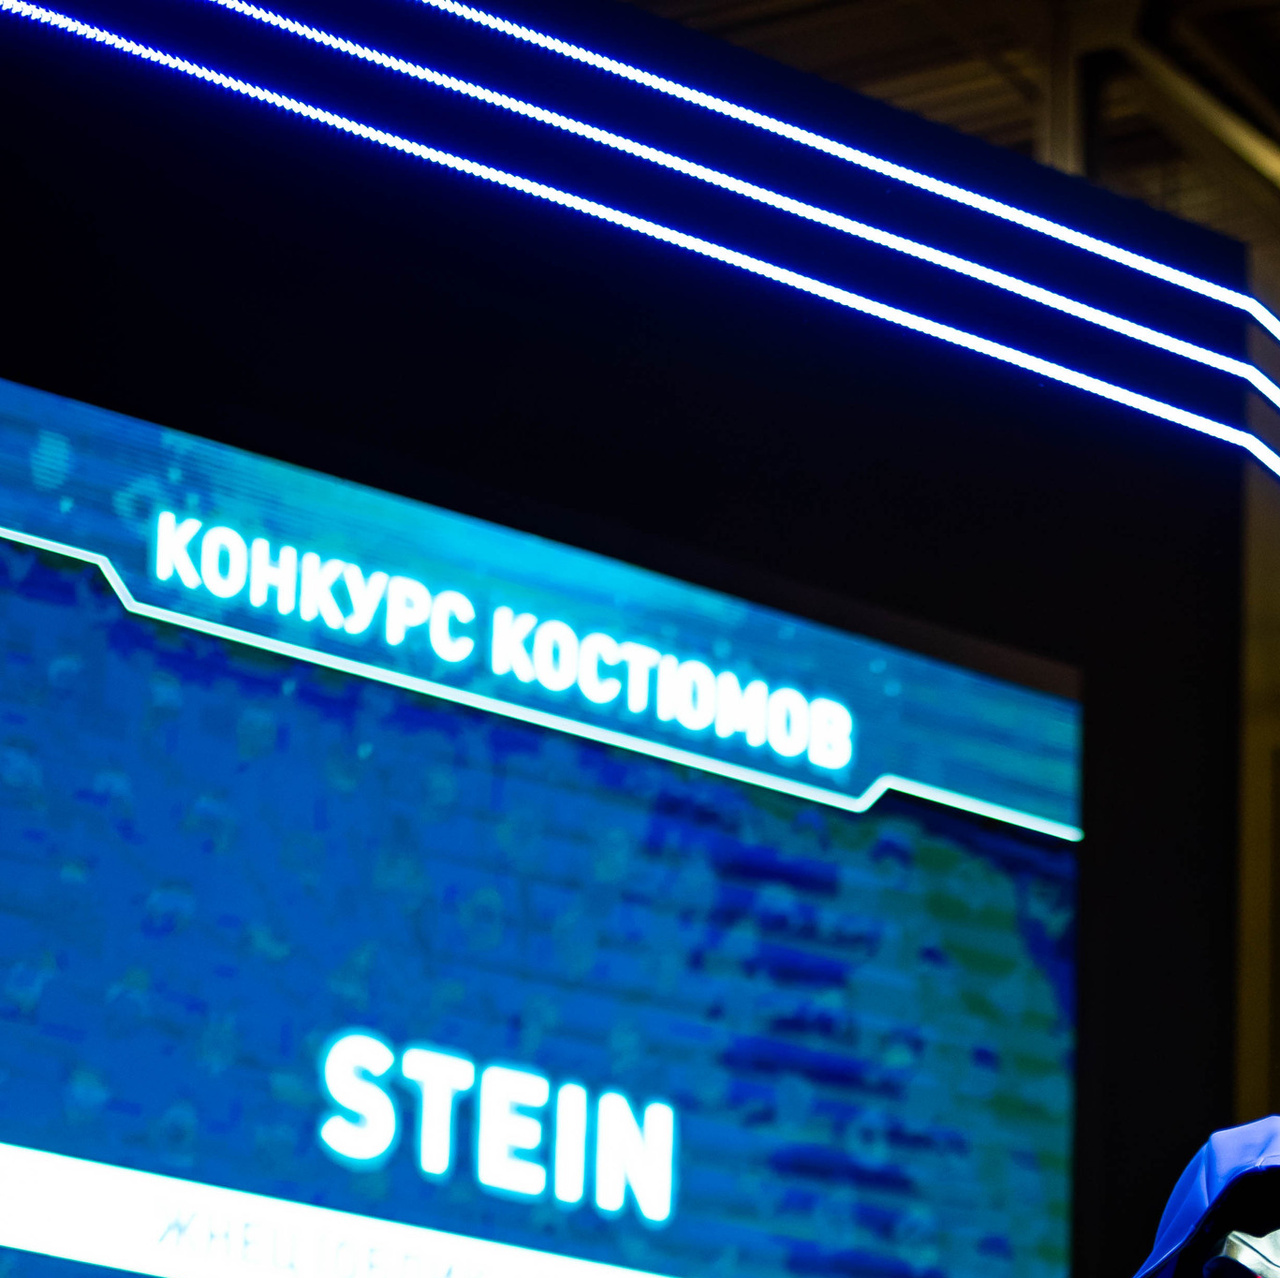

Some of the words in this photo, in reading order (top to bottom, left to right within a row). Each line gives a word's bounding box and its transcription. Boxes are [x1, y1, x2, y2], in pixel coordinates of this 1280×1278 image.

[155, 510, 476, 663] КОНКУРС
[490, 605, 853, 770] КОСТЮМОВ
[319, 1033, 675, 1223] STEIN
